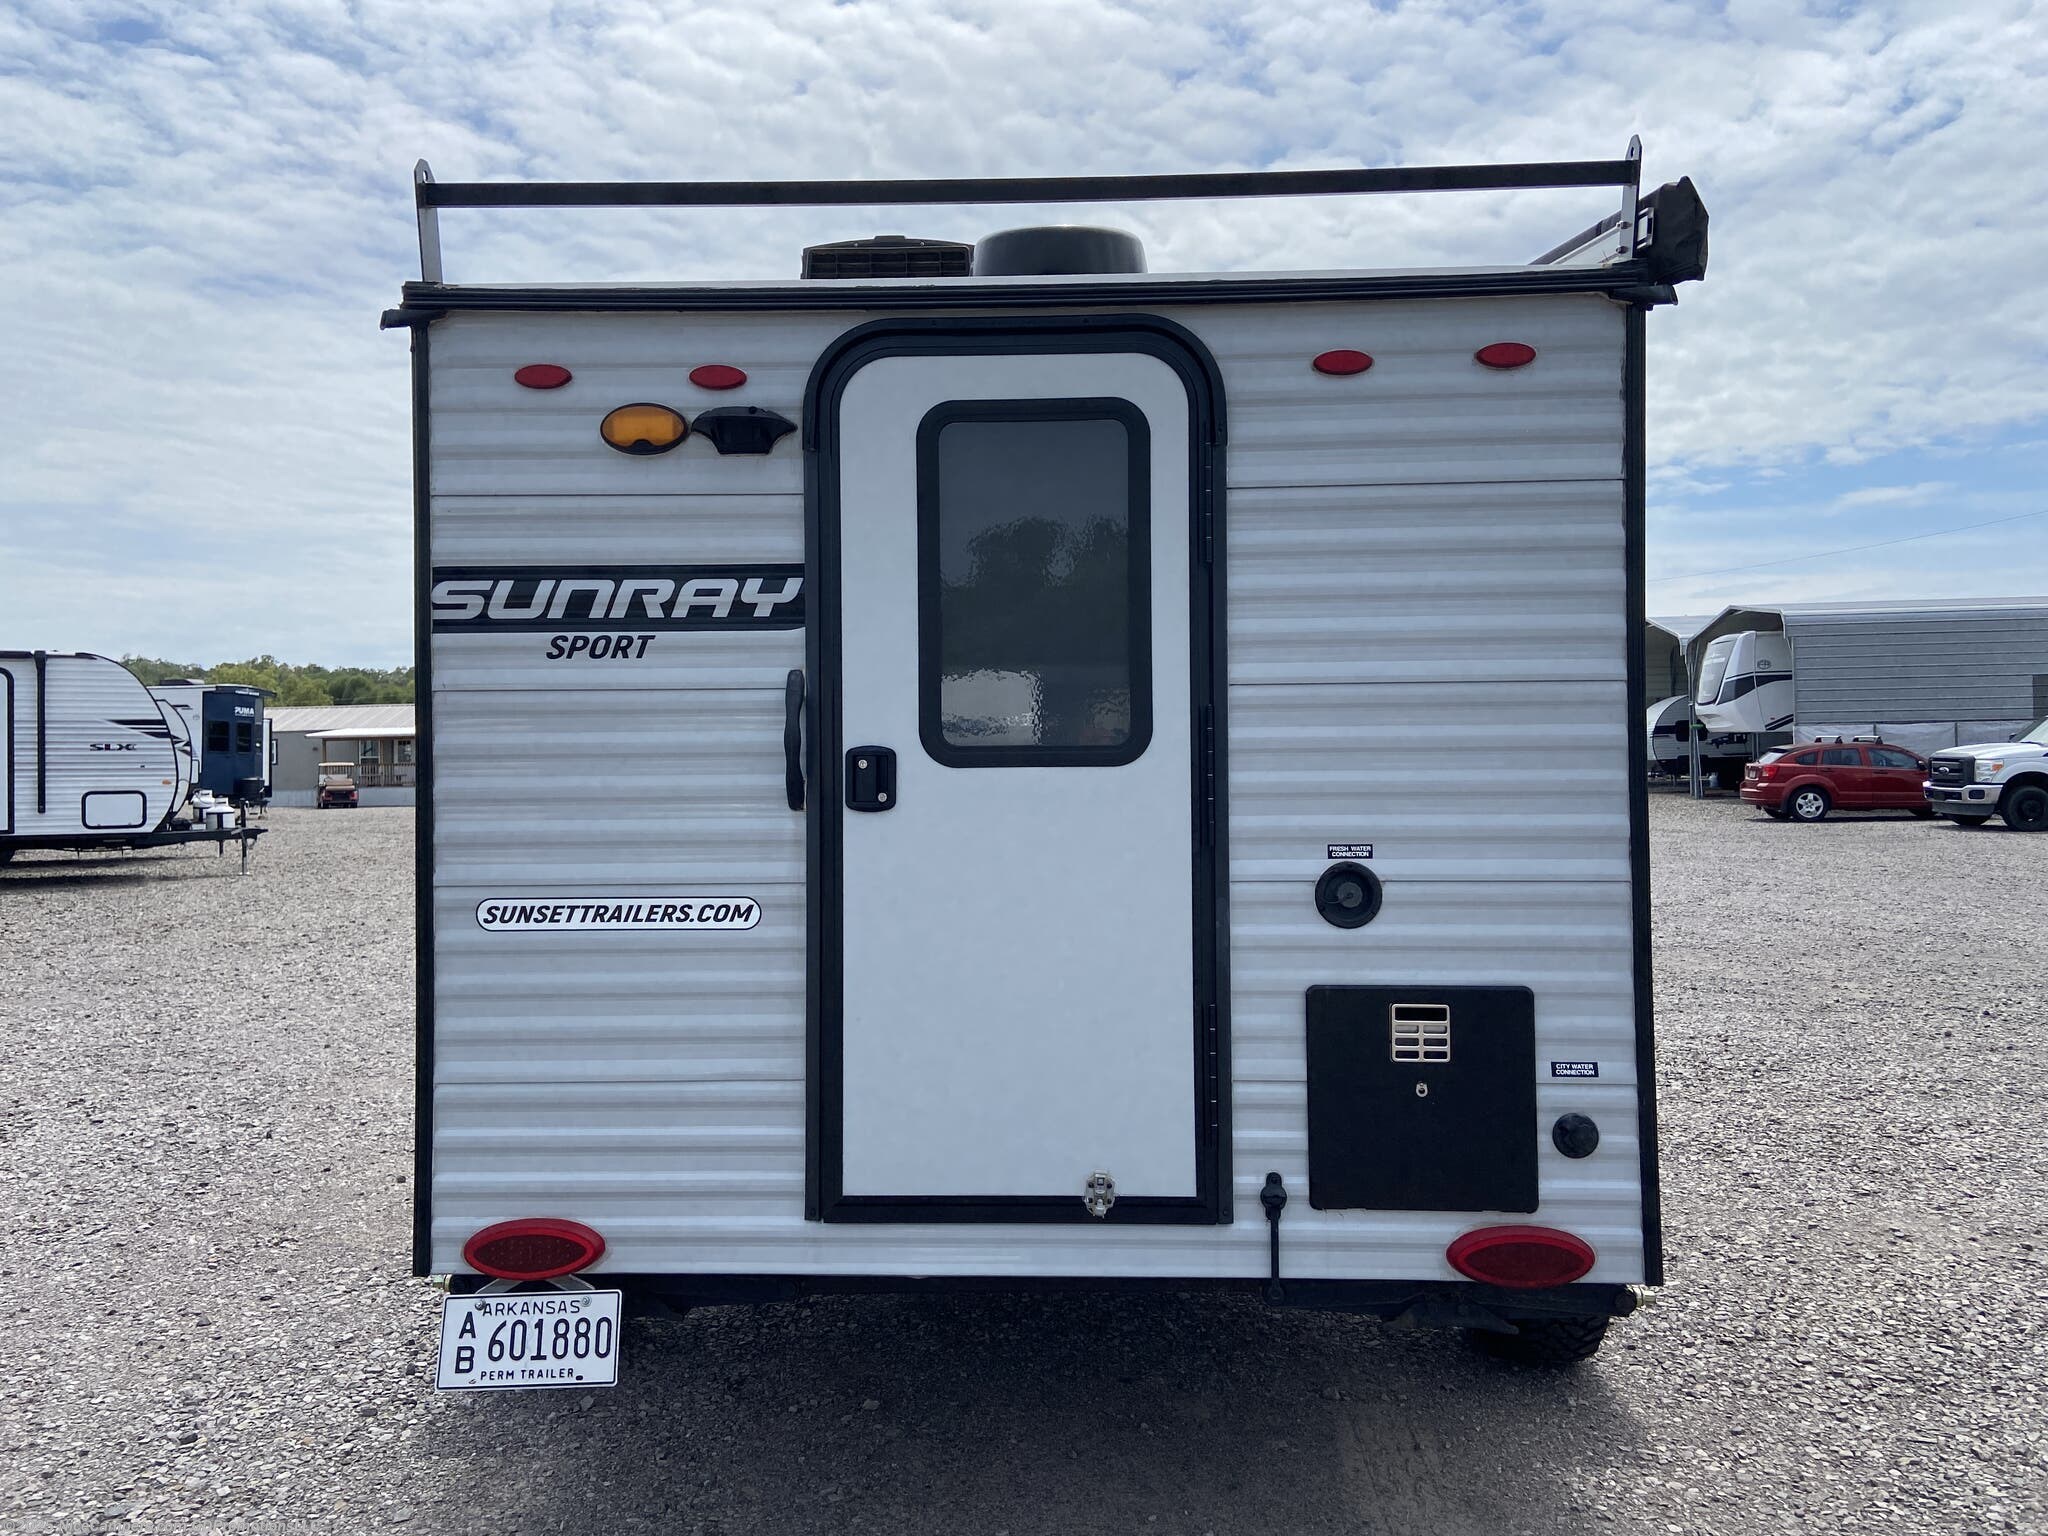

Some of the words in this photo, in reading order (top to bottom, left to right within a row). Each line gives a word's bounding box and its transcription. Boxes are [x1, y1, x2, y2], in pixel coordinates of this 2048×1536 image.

[431, 577, 804, 620] SUNRAY
[546, 635, 656, 660] SPORT
[234, 706, 255, 715] PUMA
[483, 903, 754, 924] SUNSETTRAILERS.COM
[482, 1299, 581, 1317] ARKANSAS
[487, 1317, 613, 1362] 601880
[480, 1369, 515, 1381] PERM
[520, 1367, 575, 1380] TRAILER
